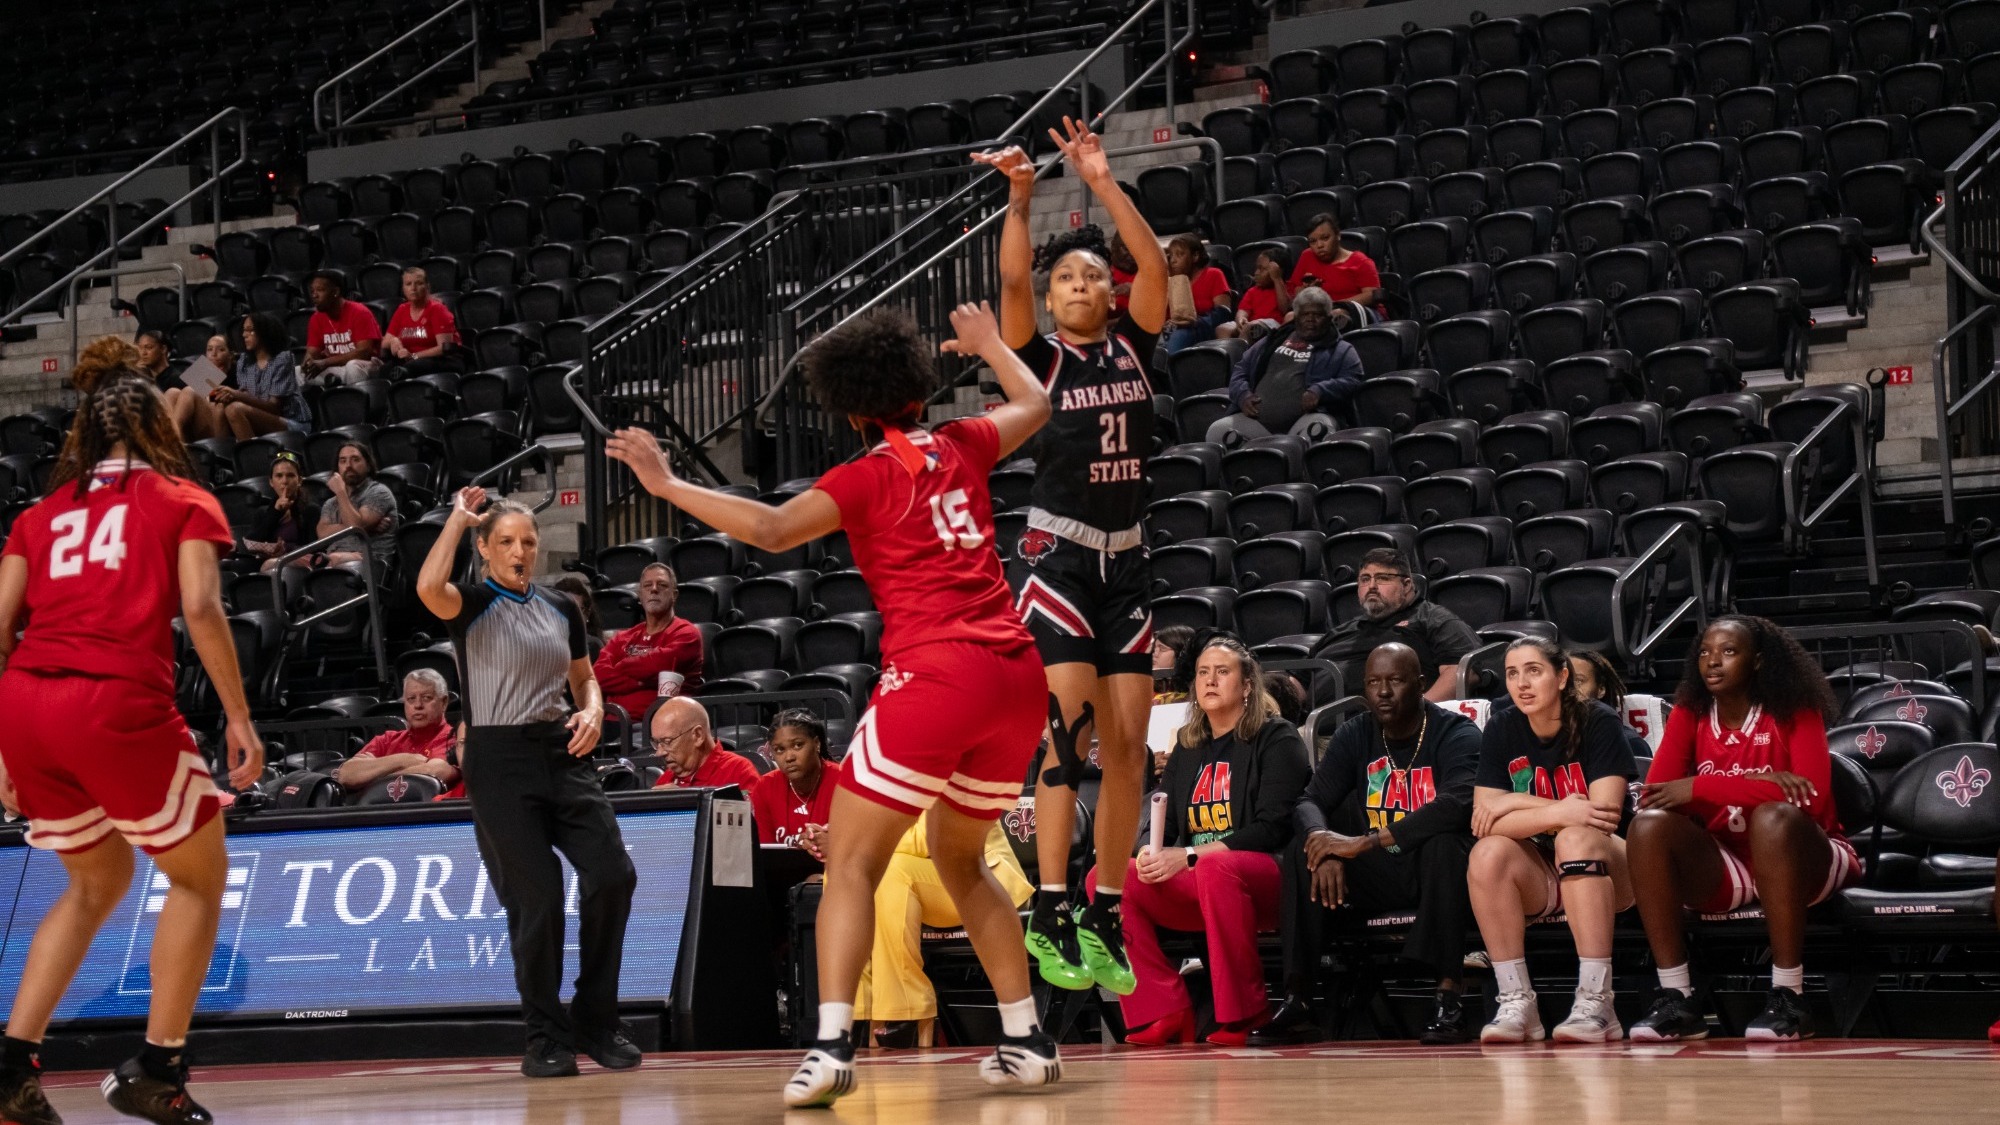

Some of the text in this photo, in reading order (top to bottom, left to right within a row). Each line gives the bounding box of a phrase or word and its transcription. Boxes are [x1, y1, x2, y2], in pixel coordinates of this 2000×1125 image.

[1155, 131, 1168, 141] 18
[45, 361, 56, 370] 16
[1891, 369, 1910, 383] 12
[1061, 380, 1147, 411] ARKANSAS
[1099, 412, 1128, 455] 21
[1089, 459, 1141, 483] STATE
[563, 494, 577, 505] 12
[929, 487, 985, 552] 15
[50, 503, 129, 579] 24
[1628, 709, 1650, 739] 5
[1384, 766, 1437, 812] AM
[1535, 762, 1591, 800] AM
[1188, 802, 1233, 833] LAC
[282, 845, 633, 928] TORI
[363, 932, 509, 973] LAW
[285, 1010, 349, 1019] DAKTRONICS
